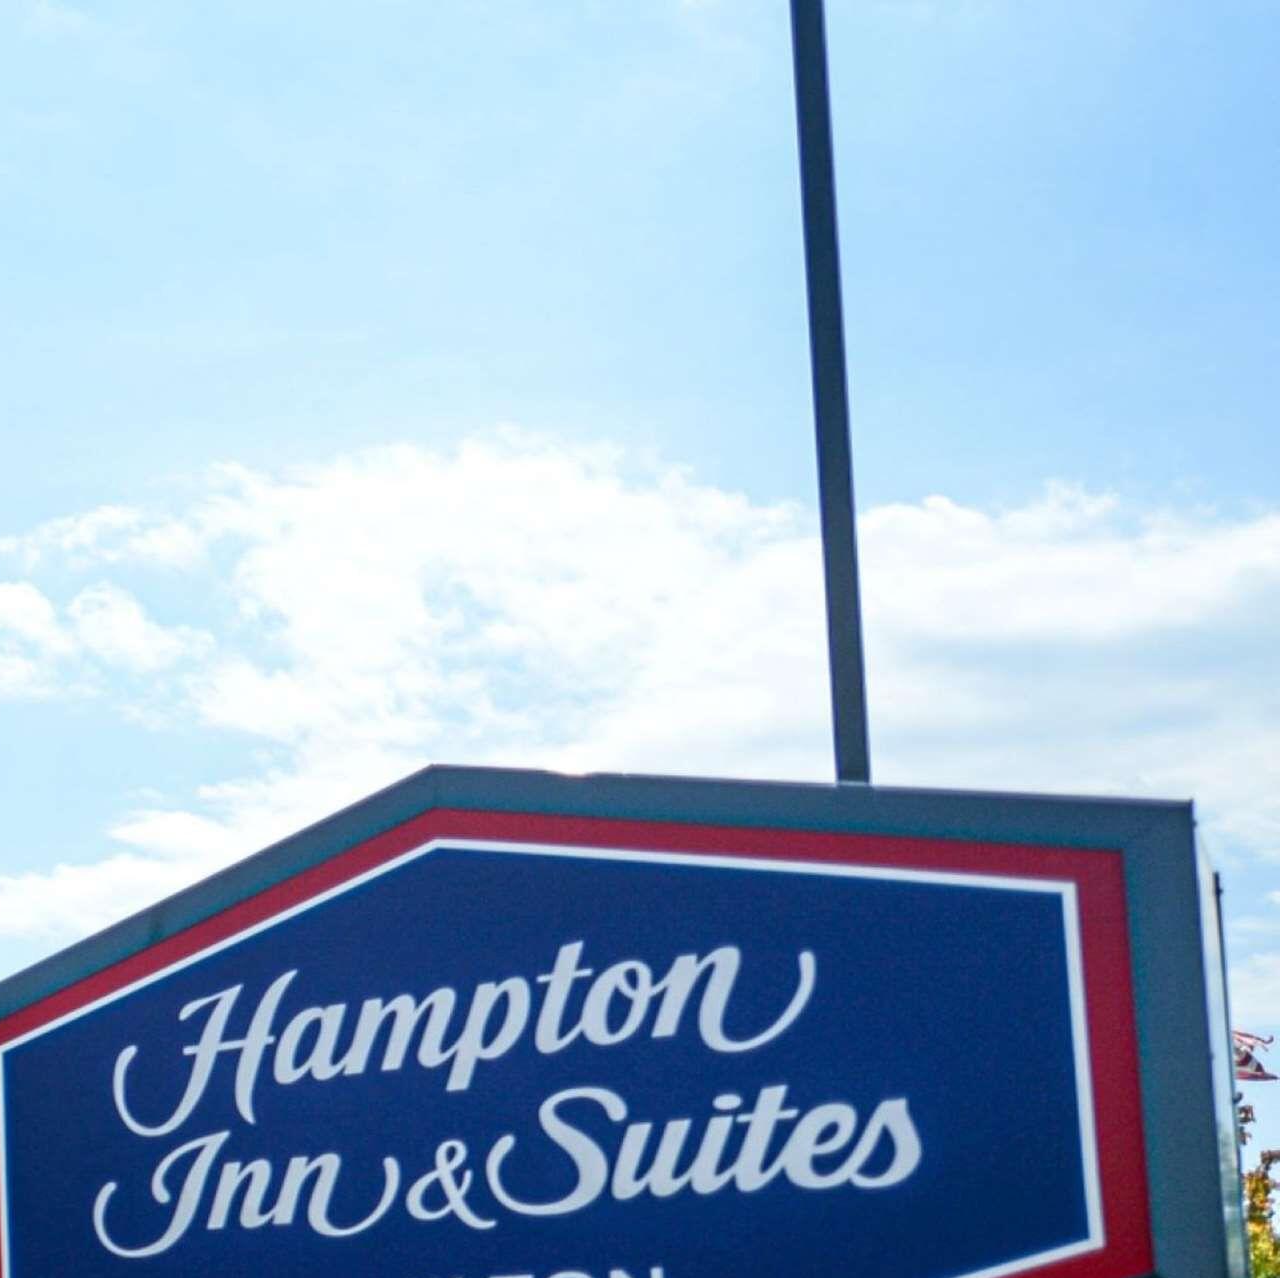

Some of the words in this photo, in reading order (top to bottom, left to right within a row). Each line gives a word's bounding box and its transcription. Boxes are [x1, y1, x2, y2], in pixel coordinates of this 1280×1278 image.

[112, 939, 816, 1138] Hampton
[92, 1129, 401, 1259] Inn
[405, 1138, 497, 1231] &
[485, 1084, 922, 1217] Suites
